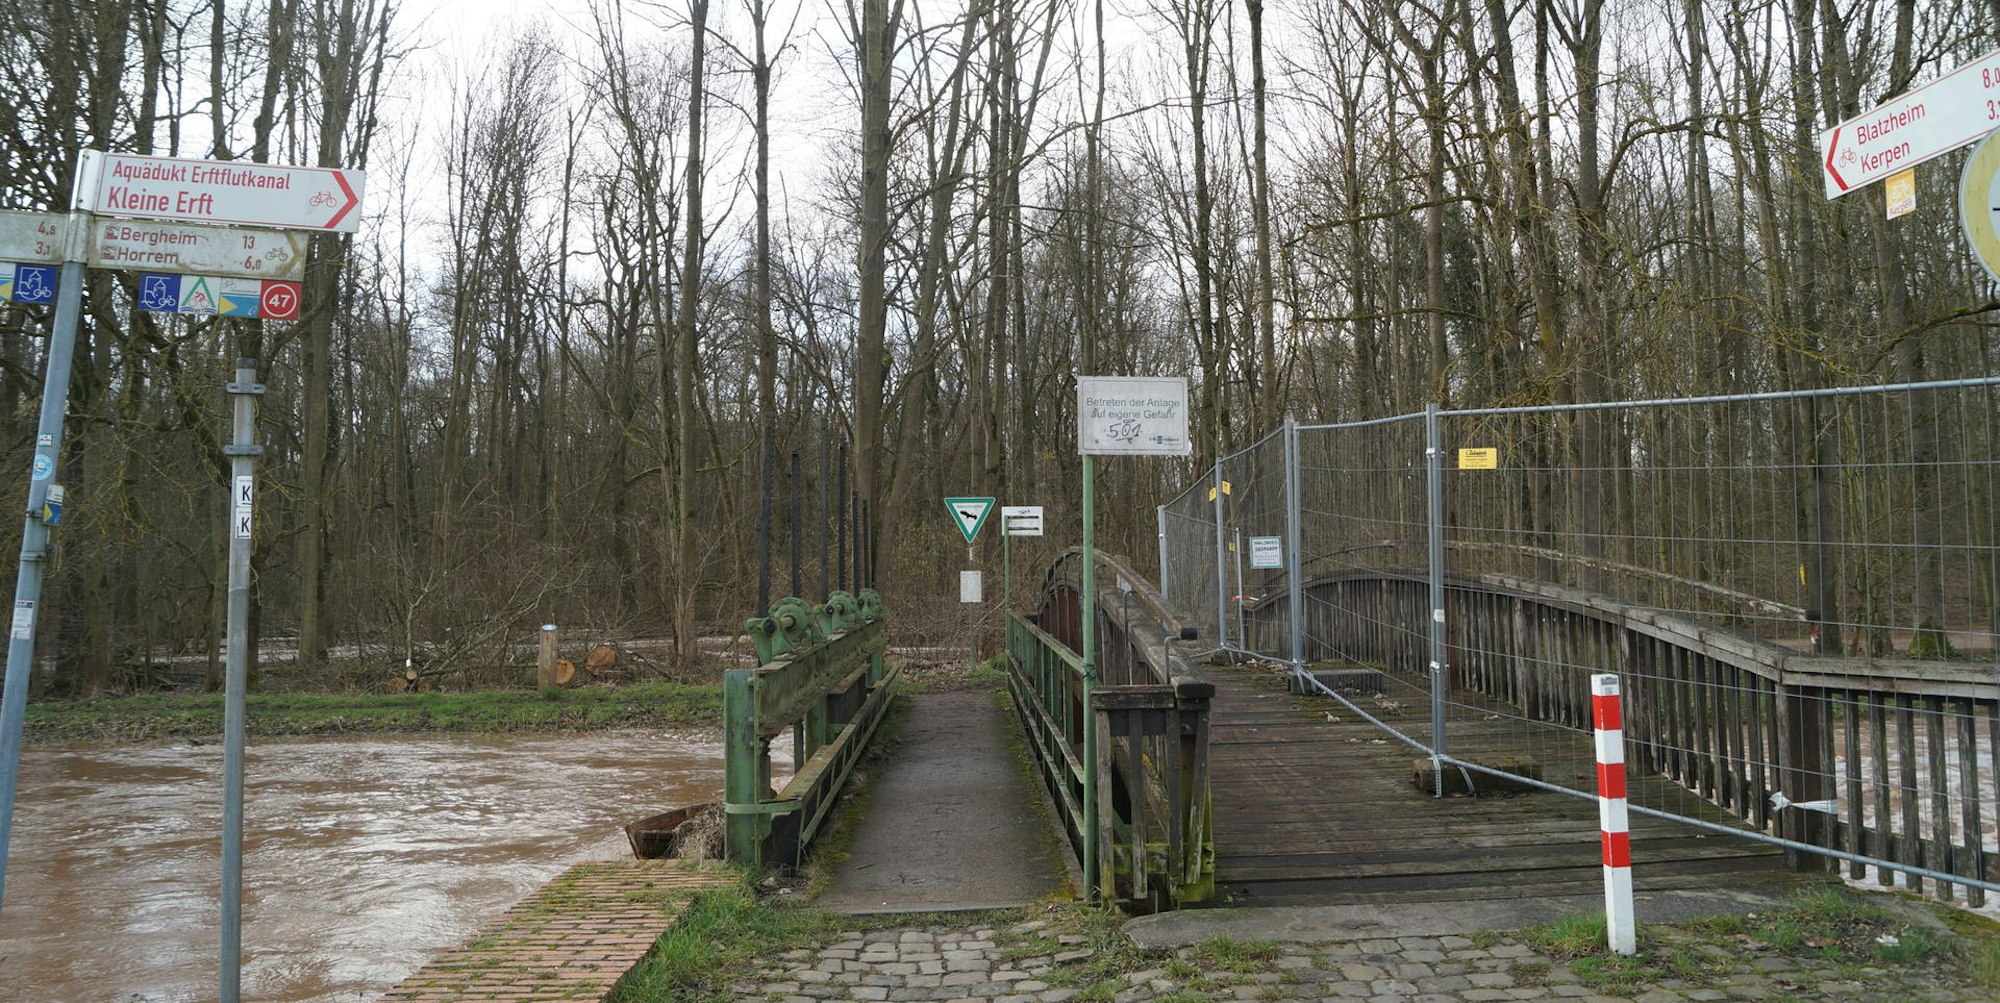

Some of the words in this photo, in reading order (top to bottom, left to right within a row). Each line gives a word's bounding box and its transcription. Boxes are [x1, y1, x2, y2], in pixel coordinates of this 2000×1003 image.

[1856, 103, 1926, 145] Blatzheim
[1860, 142, 1911, 174] Kerpen
[111, 160, 186, 183] Aquädukt
[191, 166, 291, 190] Erftflutkanal
[107, 186, 170, 213] Kleine
[176, 191, 214, 215] Erft
[120, 227, 197, 247] Bergheim
[242, 236, 256, 250] 13
[118, 247, 179, 265] Horrem
[268, 293, 291, 308] 47
[1086, 398, 1127, 407] Betreten
[1129, 398, 1145, 407] der
[1146, 398, 1180, 409] Anlage
[1091, 409, 1106, 419] auf
[1108, 411, 1141, 420] eigene
[1143, 410, 1176, 419] Gefahr
[242, 485, 251, 501] K
[241, 517, 250, 533] K
